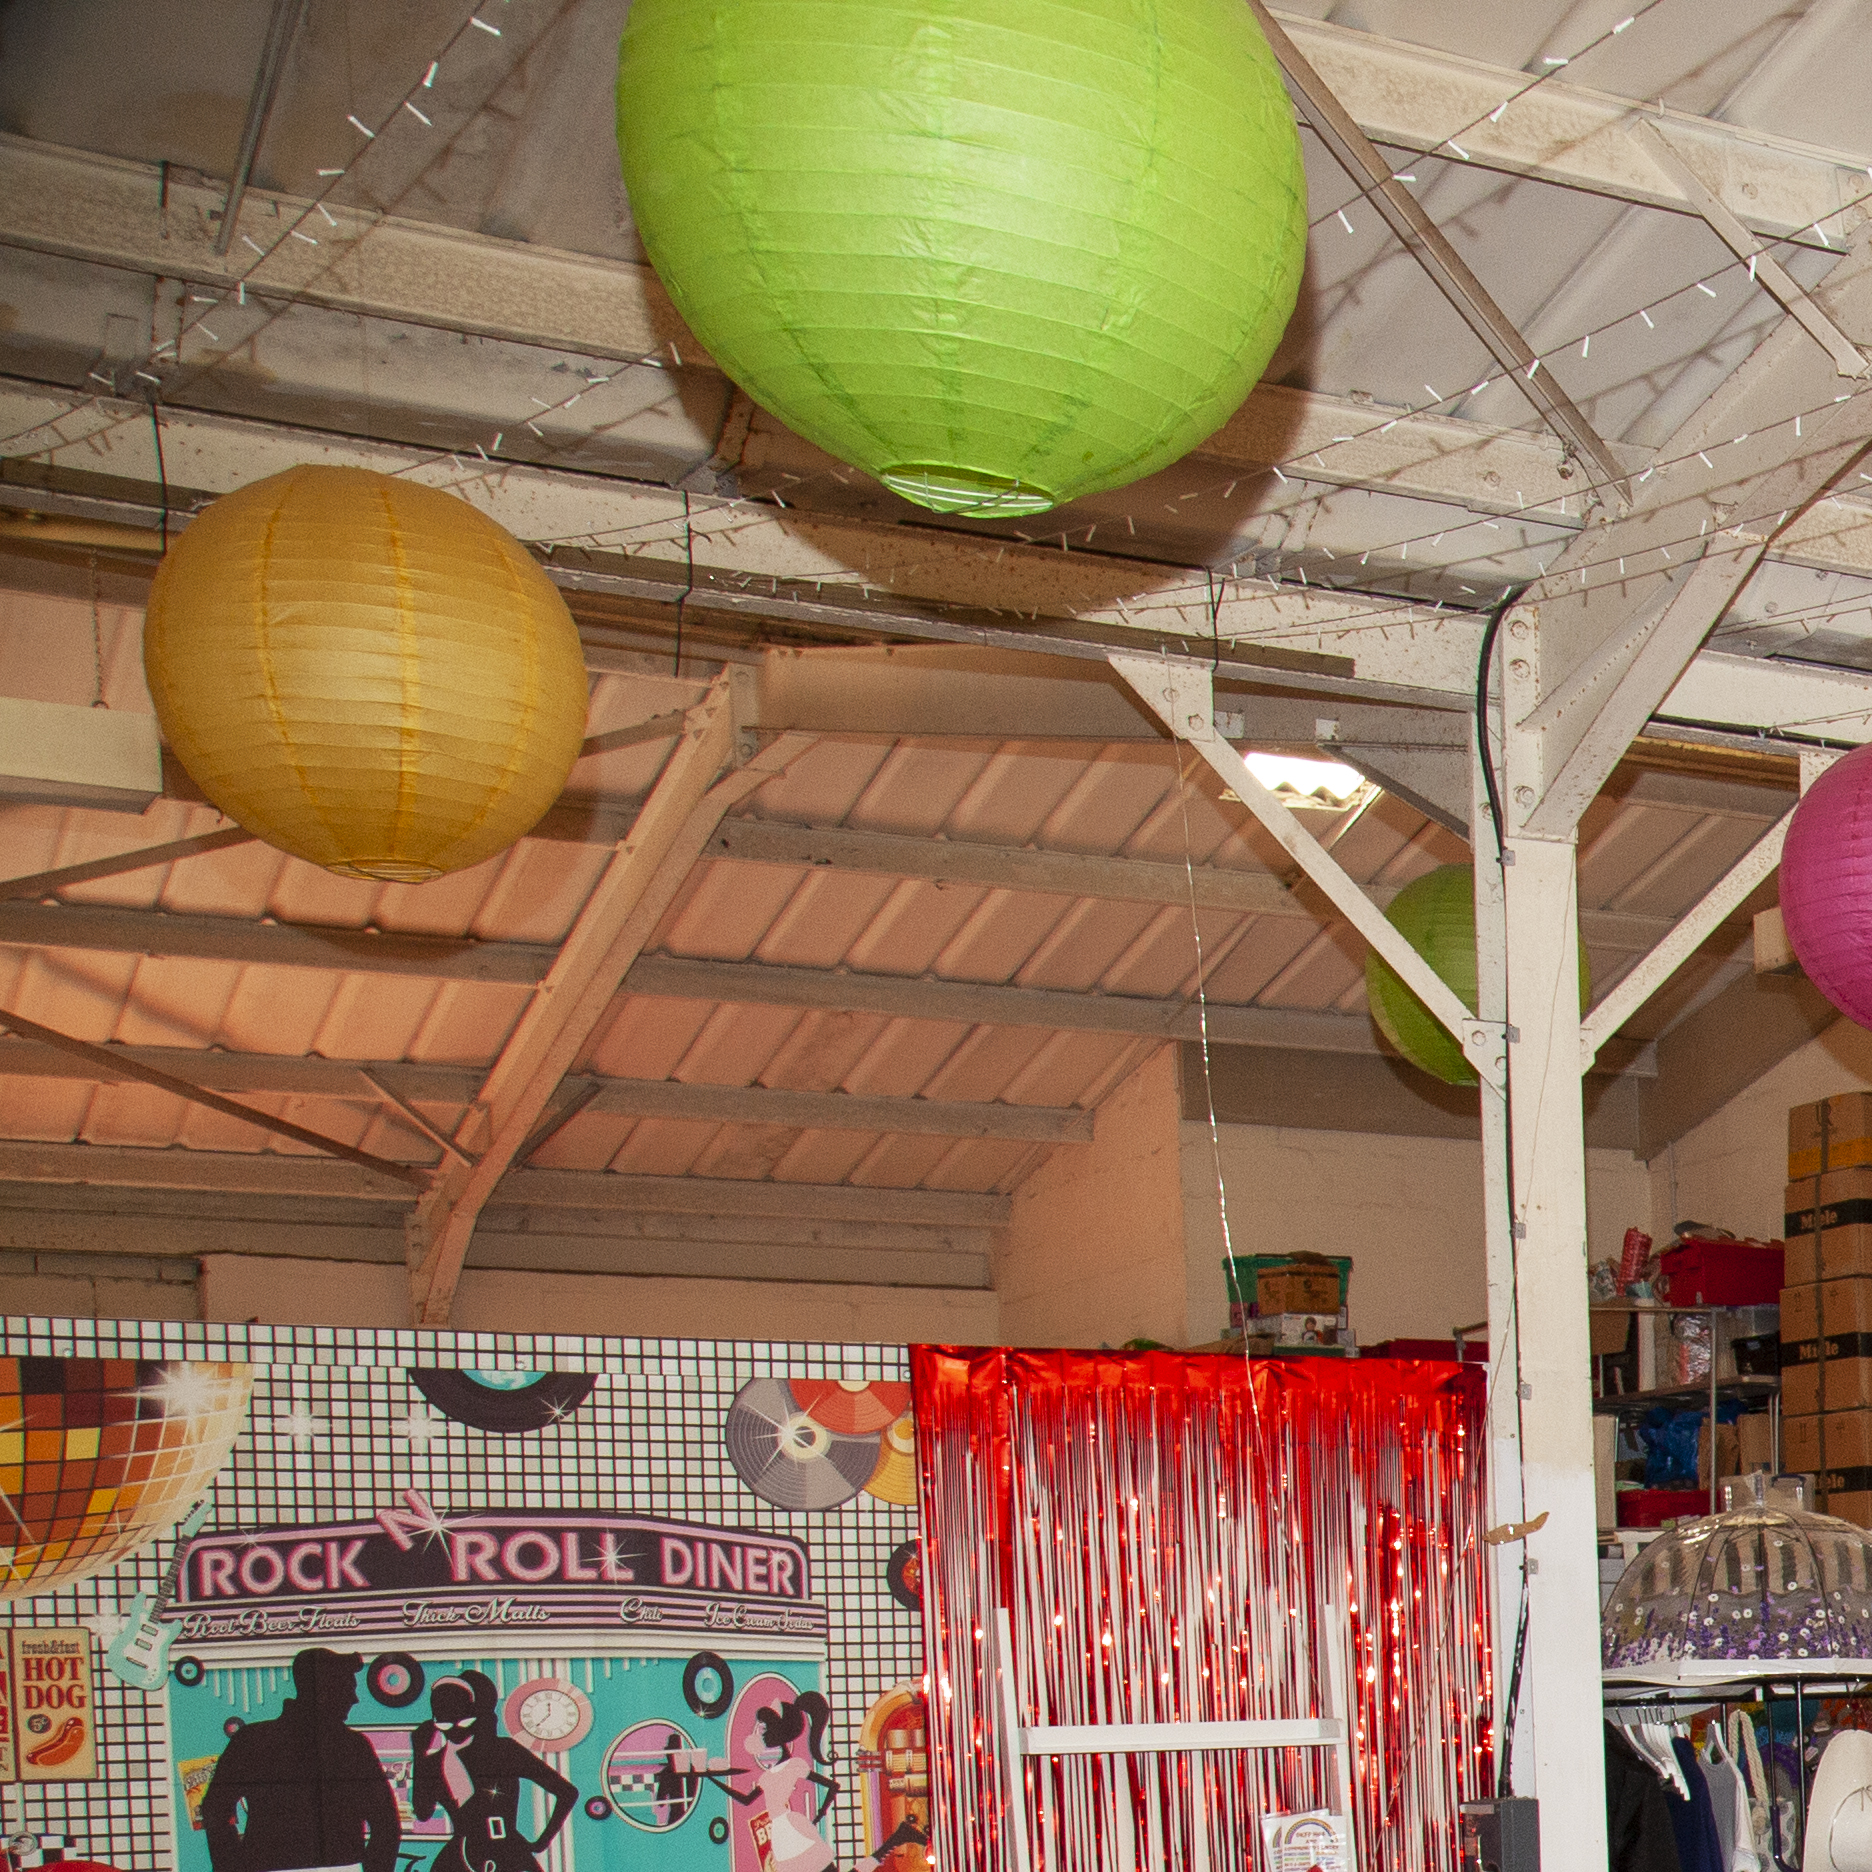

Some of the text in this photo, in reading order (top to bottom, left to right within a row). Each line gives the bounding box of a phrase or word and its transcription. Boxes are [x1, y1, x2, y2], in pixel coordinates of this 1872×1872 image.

[199, 1537, 371, 1598] ROCK
[450, 1529, 636, 1584] ROLL
[659, 1535, 796, 1597] DINER
[21, 1656, 85, 1682] HOT
[23, 1683, 87, 1710] DOG
